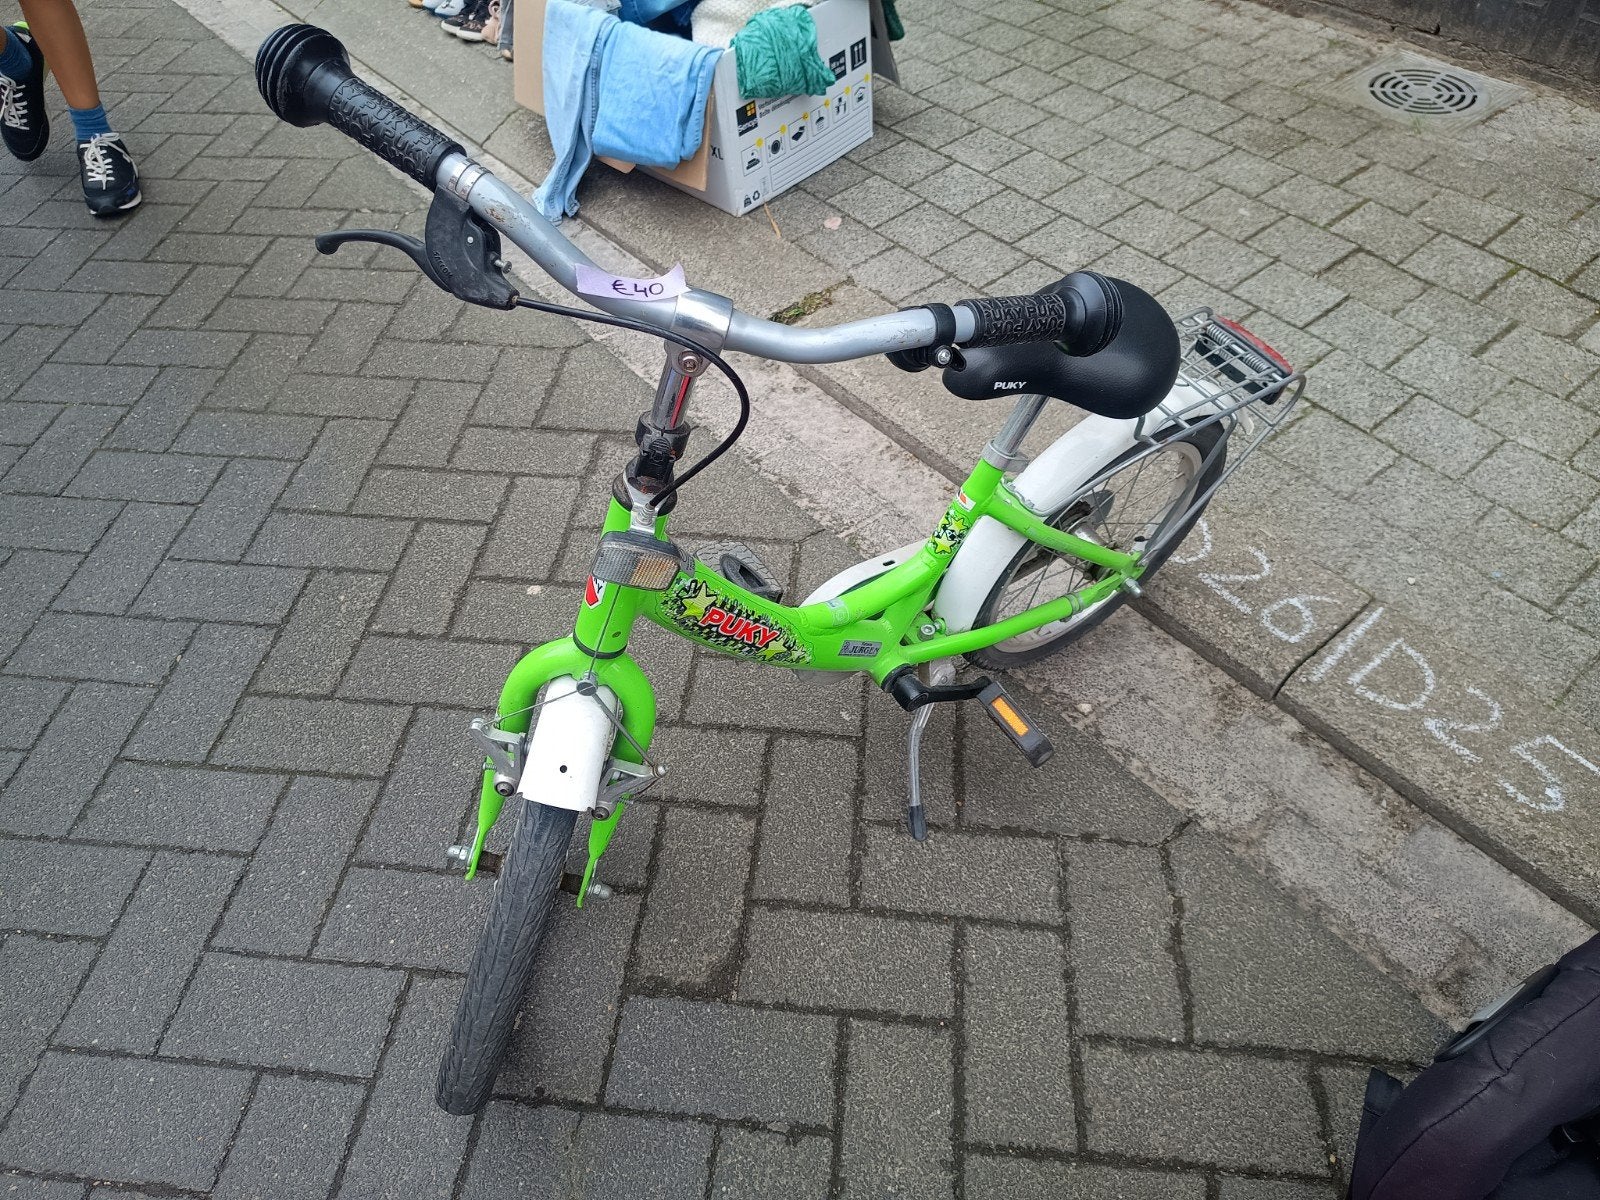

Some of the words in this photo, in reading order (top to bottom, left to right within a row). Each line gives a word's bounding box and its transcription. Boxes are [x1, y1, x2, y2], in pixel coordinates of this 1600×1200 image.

[709, 144, 724, 161] XL
[993, 381, 1027, 390] PUKY
[698, 606, 780, 648] PUKY
